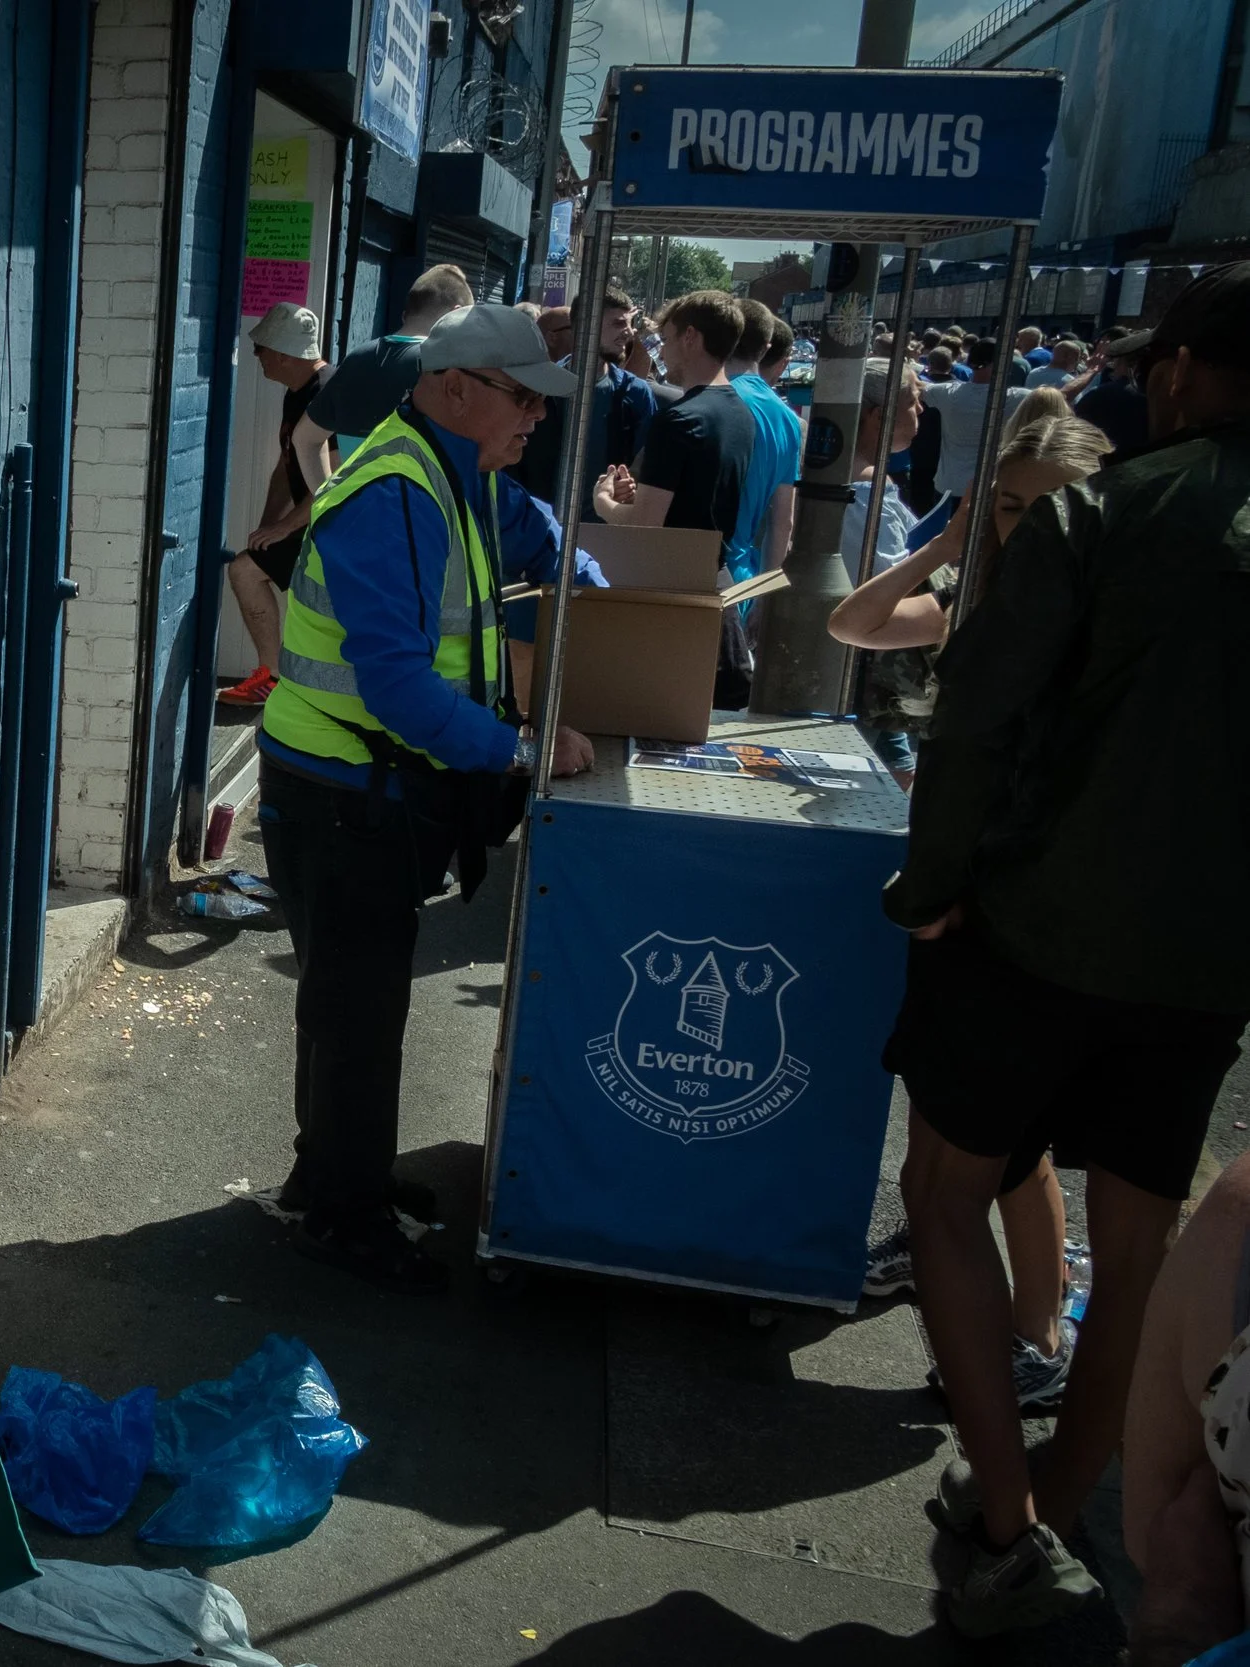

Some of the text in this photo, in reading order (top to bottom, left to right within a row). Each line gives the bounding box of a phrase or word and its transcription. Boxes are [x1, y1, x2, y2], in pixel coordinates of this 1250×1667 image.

[667, 107, 984, 178] PROGRAMMES
[254, 151, 288, 167] ASH
[544, 273, 565, 281] RPLE
[544, 281, 565, 289] ICKS
[636, 1042, 755, 1081] Everton
[596, 1062, 794, 1134] NIL SATIS NISI OPTIMUM
[673, 1079, 711, 1098] 1878
